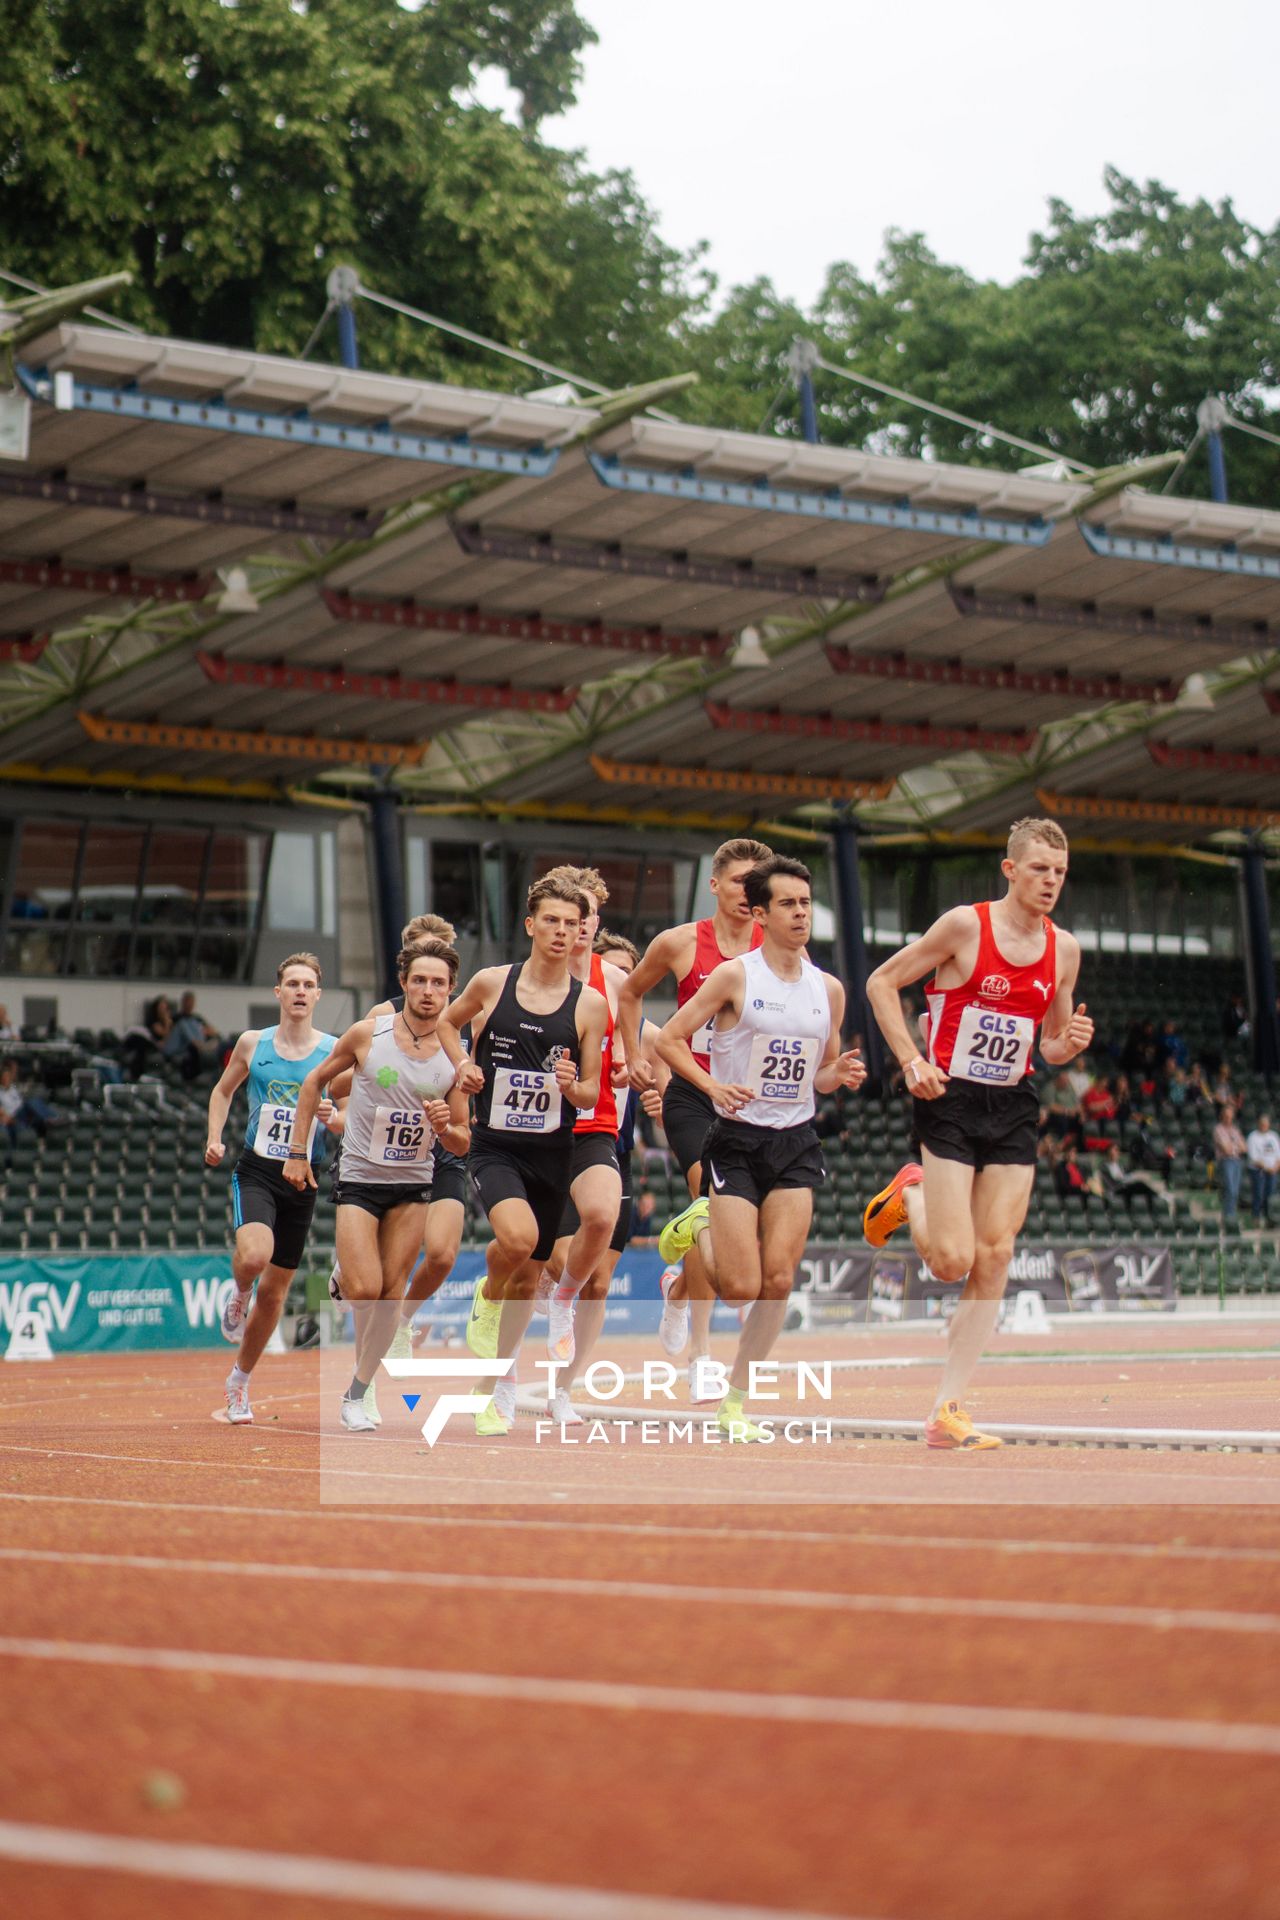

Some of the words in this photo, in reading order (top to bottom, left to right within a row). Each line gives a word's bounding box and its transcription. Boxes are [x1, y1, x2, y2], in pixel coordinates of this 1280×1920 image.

[520, 1023, 538, 1032] CRAFT
[979, 1015, 1017, 1035] GLS
[769, 1039, 802, 1055] GLS
[968, 1031, 1020, 1064] 202
[761, 1056, 806, 1081] 236
[987, 1067, 1009, 1076] PLAN
[510, 1073, 544, 1089] GLS
[778, 1085, 798, 1094] PLAN
[504, 1090, 550, 1113] 470
[273, 1109, 296, 1123] GL
[390, 1111, 421, 1125] GLS
[522, 1116, 544, 1124] PLAN
[268, 1123, 292, 1143] 41
[385, 1125, 424, 1147] 162
[399, 1149, 417, 1157] PLAN
[87, 1290, 112, 1309] GUT
[98, 1309, 121, 1327] UND
[123, 1308, 144, 1326] GUT
[20, 1320, 35, 1340] 4
